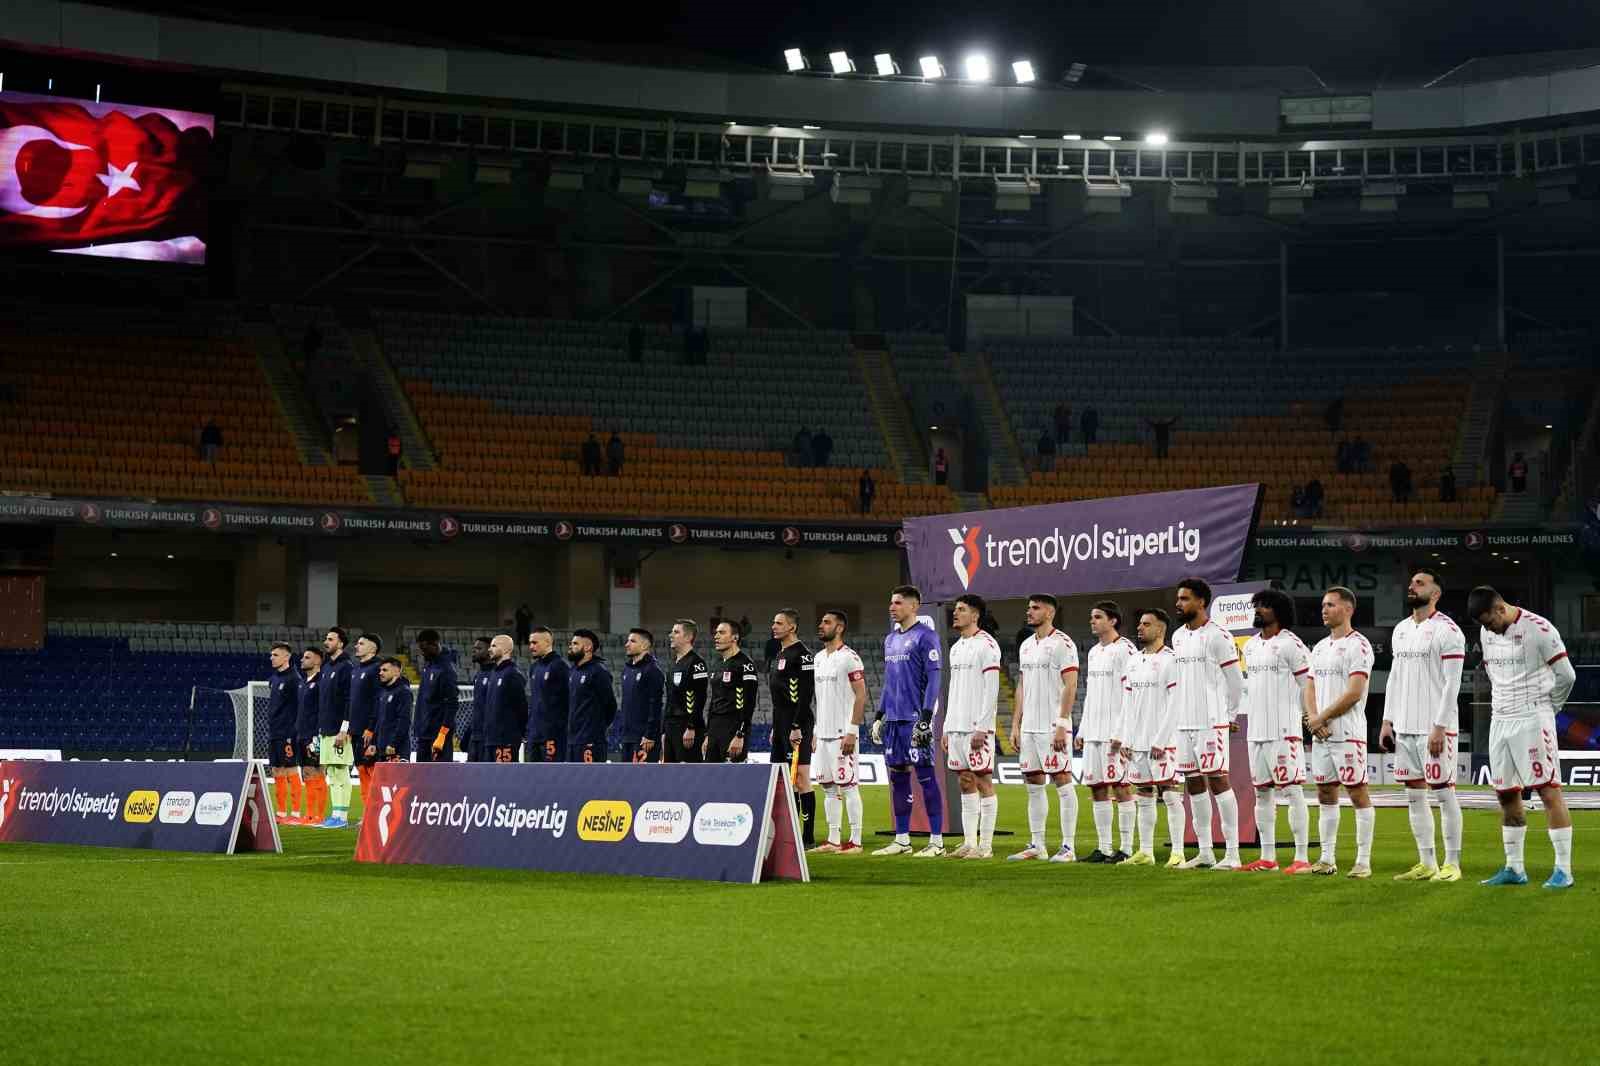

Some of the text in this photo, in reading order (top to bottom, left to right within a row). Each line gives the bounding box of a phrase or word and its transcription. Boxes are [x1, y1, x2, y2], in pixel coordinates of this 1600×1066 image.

[30, 506, 74, 517] AIRLINES
[105, 509, 196, 522] TURKISH AIRLINES
[225, 514, 314, 527] TURKISH AIRLINES
[344, 518, 431, 531] TURKISH AIRLINES
[462, 523, 549, 536] TURKISH AIRLINES
[576, 526, 663, 538] TURKISH AIRLINES
[690, 529, 776, 541] TURKISH AIRLINES
[803, 531, 888, 544] TURKISH AIRLINES
[1256, 537, 1342, 548] TURKISH AIRLINES
[1371, 536, 1458, 547] TURKISH AIRLINES
[1487, 534, 1574, 545] TURKISH AIRLINES
[985, 521, 1200, 570] trendyol süperLig
[1218, 600, 1253, 613] trendyo
[969, 752, 983, 767] 53
[1044, 754, 1059, 768] 44
[1200, 752, 1215, 769] 27
[838, 767, 846, 780] 3
[1107, 764, 1116, 778] 8
[1159, 763, 1167, 776] 7
[1273, 766, 1288, 781] 12
[1339, 766, 1355, 782] 22
[1426, 763, 1441, 780] 80
[1532, 761, 1543, 778] 9
[18, 787, 76, 817] trendyol
[408, 796, 494, 836] trendyol
[644, 807, 683, 822] trendyol
